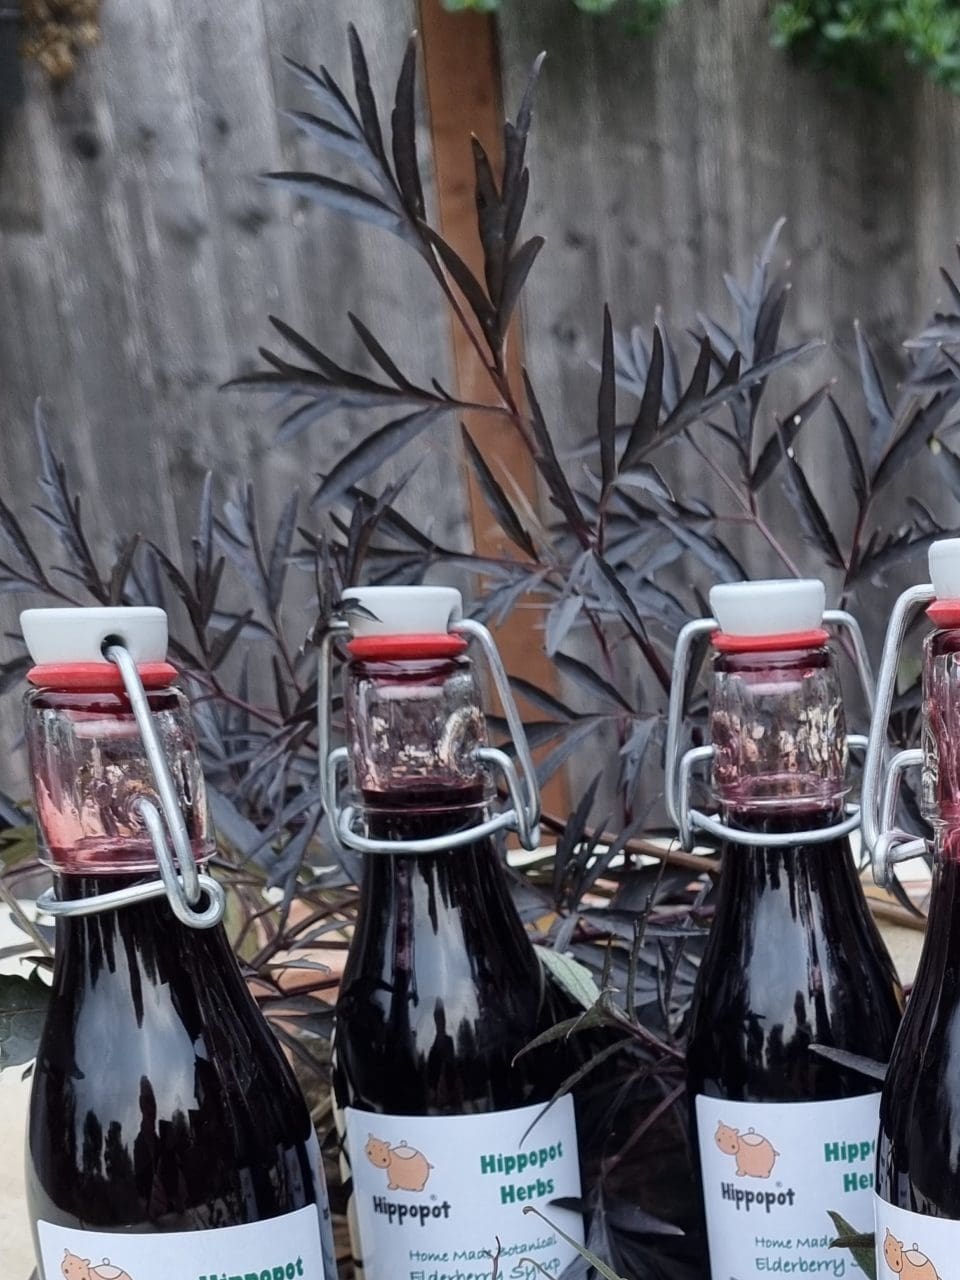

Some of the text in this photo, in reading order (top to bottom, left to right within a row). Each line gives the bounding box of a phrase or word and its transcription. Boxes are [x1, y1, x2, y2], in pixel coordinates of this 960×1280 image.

[480, 1141, 563, 1174] Hippopot
[500, 1177, 555, 1204] Herbs
[721, 1182, 796, 1213] Hippopot
[373, 1195, 451, 1226] Hippopot
[409, 1249, 449, 1262] Home
[755, 1235, 793, 1249] Home
[755, 1257, 845, 1277] Elderberry
